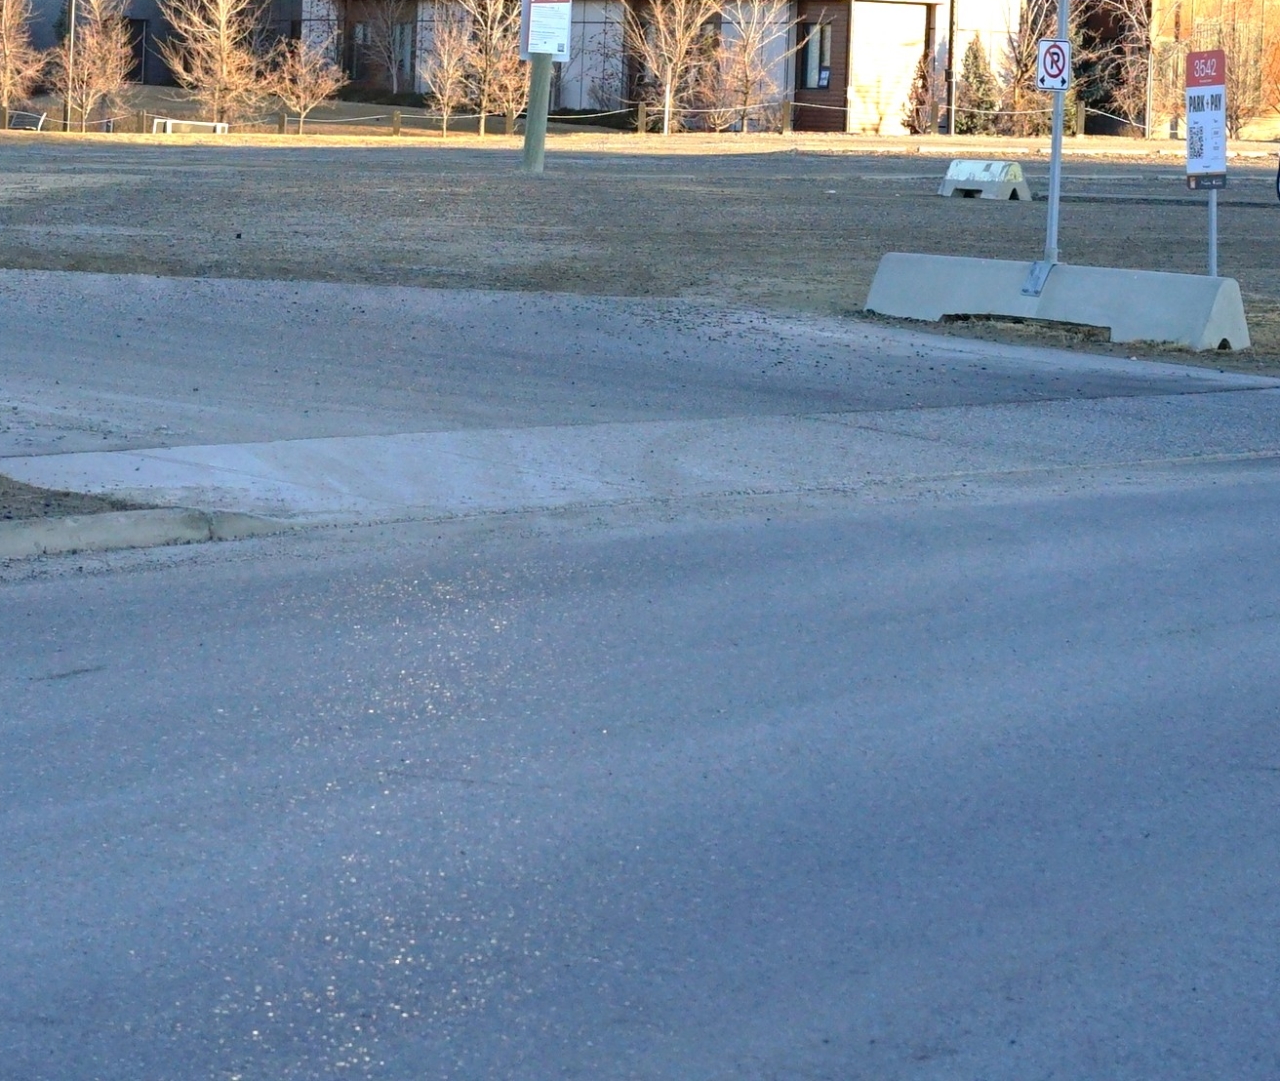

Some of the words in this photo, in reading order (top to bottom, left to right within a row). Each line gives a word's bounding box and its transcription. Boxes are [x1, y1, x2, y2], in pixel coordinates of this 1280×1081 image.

[1194, 59, 1217, 77] 3542
[1189, 95, 1205, 113] PARK
[1210, 94, 1222, 111] PAY
